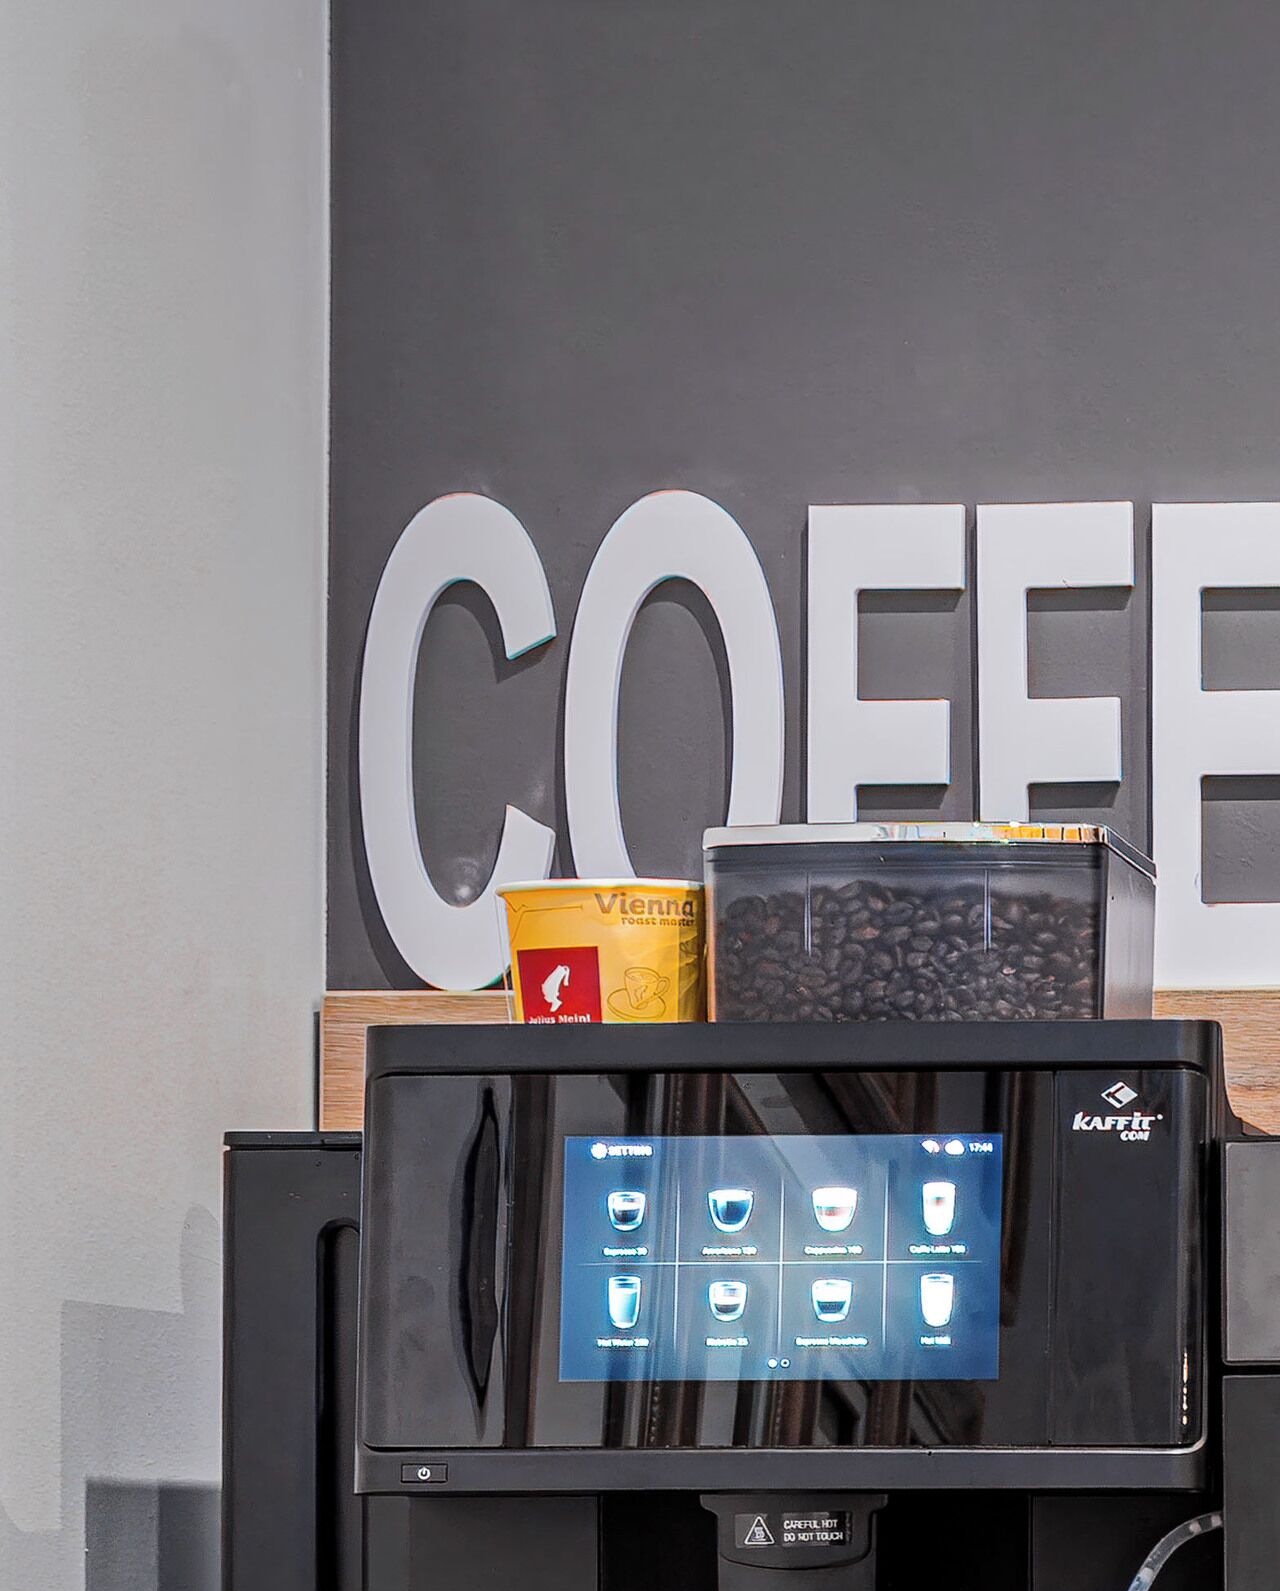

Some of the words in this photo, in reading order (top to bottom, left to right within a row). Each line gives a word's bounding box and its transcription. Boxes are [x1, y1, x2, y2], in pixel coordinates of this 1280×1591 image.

[594, 892, 694, 917] Vienna
[621, 917, 656, 926] roast
[659, 917, 694, 927] master
[783, 1520, 820, 1530] CAREFUL
[821, 1519, 838, 1528] HOT
[783, 1532, 795, 1542] DO
[798, 1533, 814, 1542] NOT
[816, 1532, 843, 1541] TOUCH
